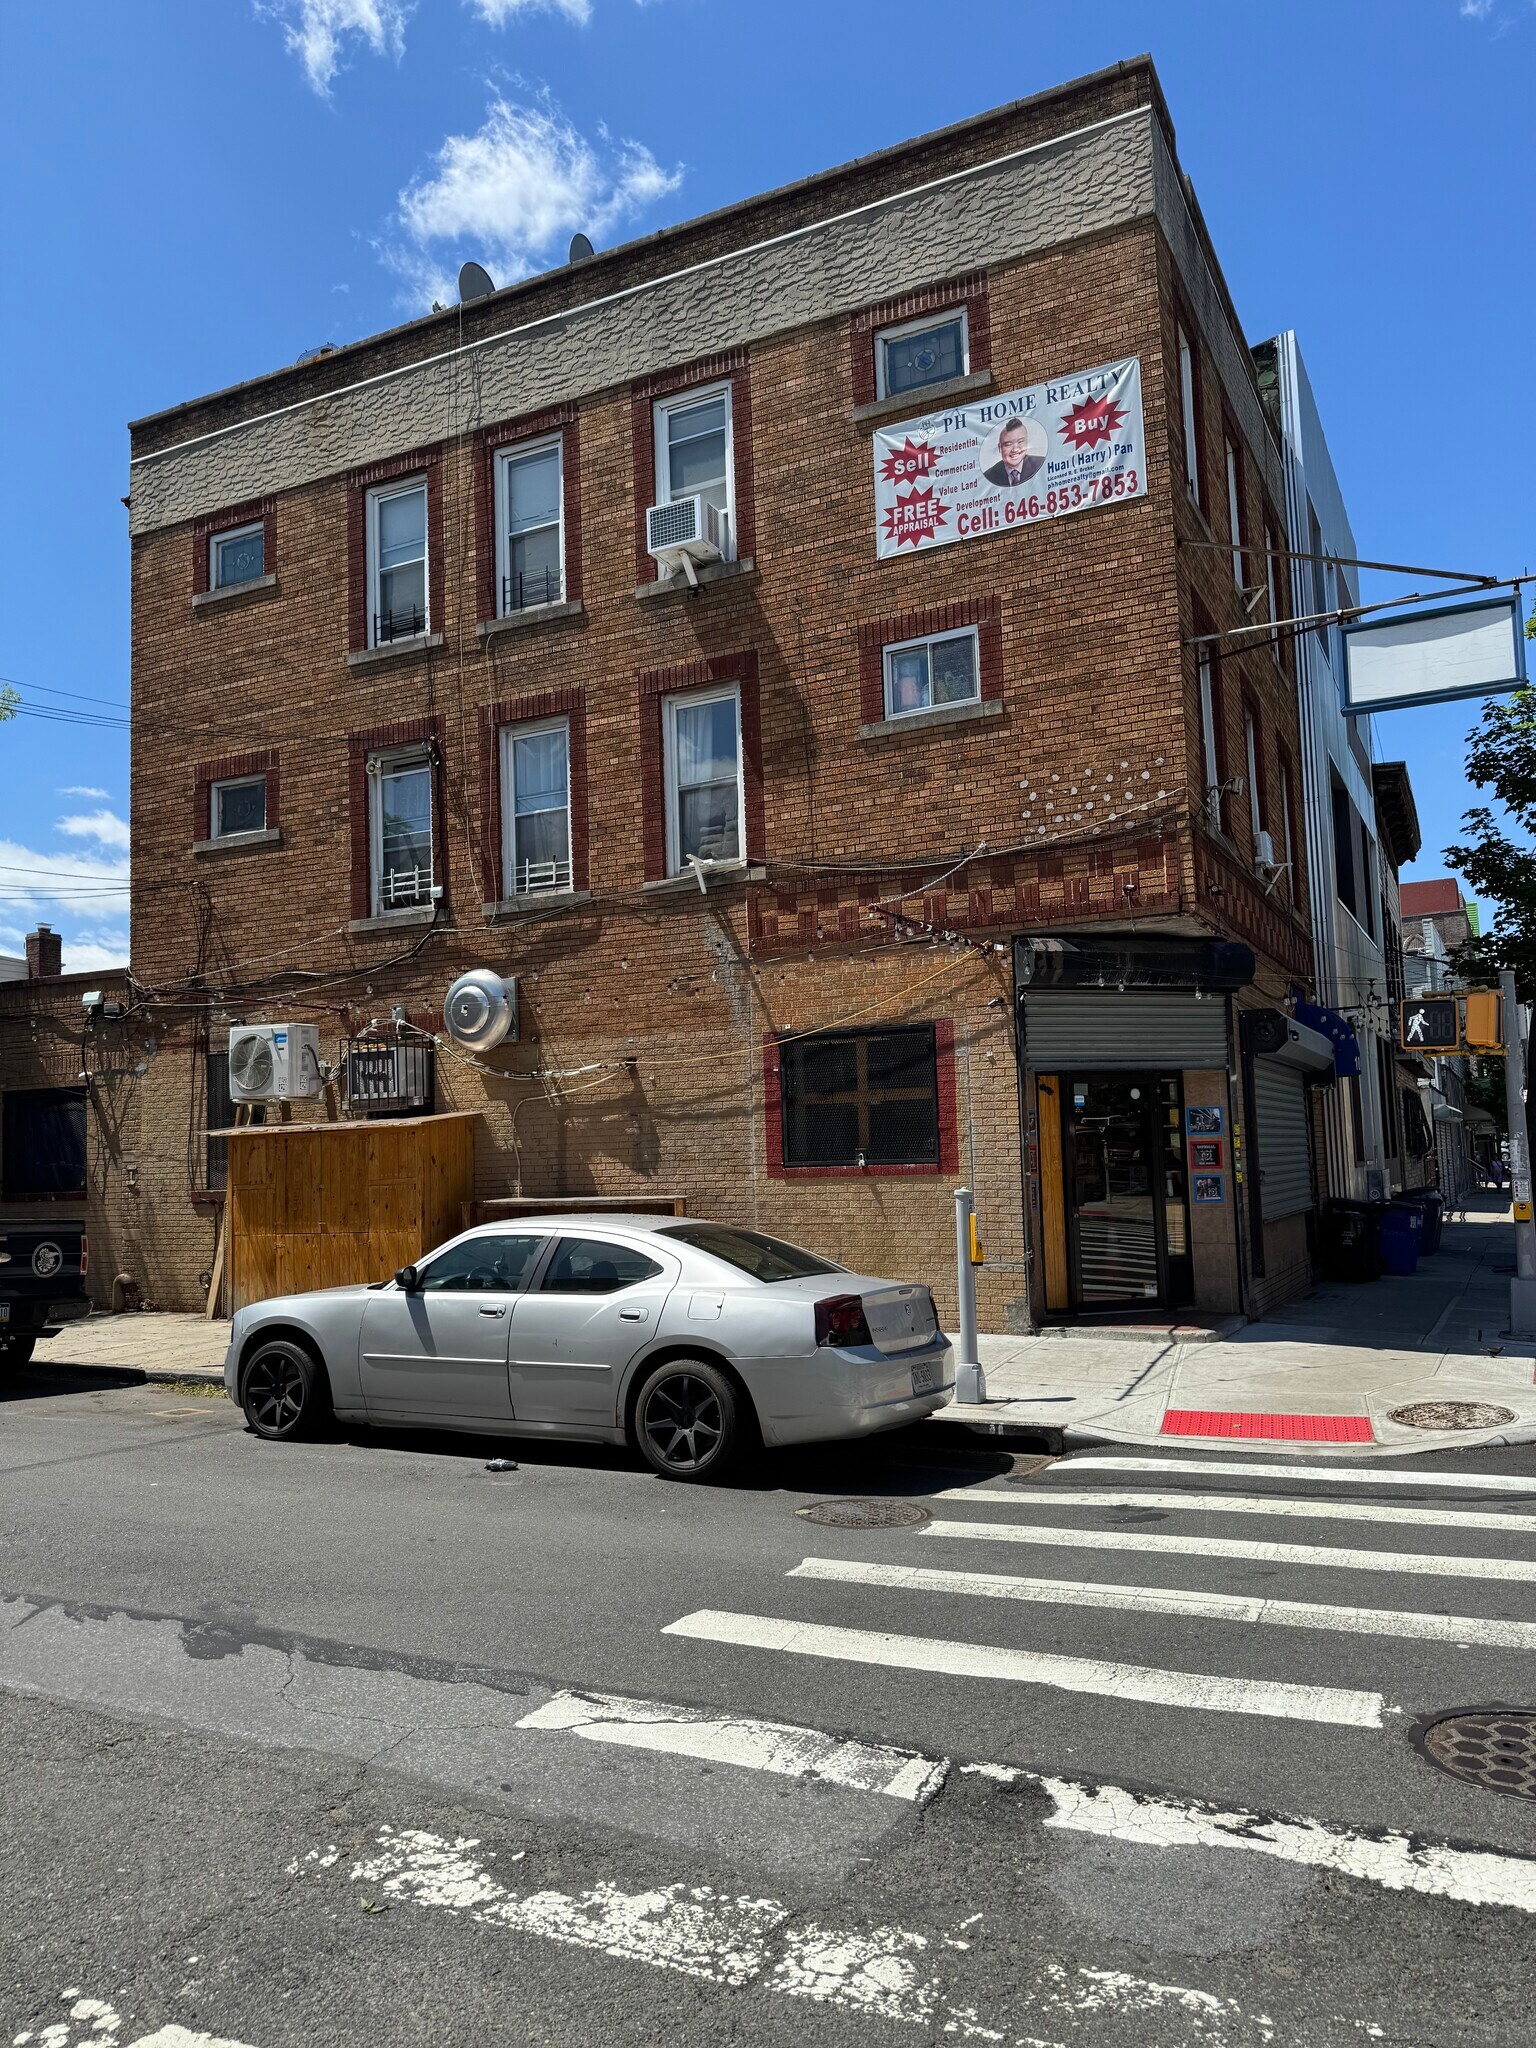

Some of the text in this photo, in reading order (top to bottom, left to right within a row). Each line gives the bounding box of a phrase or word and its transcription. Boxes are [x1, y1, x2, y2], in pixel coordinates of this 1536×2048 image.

[943, 368, 1124, 433] PH HOME REALTY
[1074, 414, 1109, 435] Buy
[939, 437, 978, 455] Residential
[1114, 443, 1133, 456] Pan
[894, 452, 929, 476] Sell
[935, 460, 976, 478] Commercial
[939, 479, 978, 497] Value Land
[893, 499, 938, 525] FREE
[956, 493, 1001, 512] Development
[957, 470, 1139, 536] Cell: 646-853-7853
[893, 517, 939, 536] APPRAISAL
